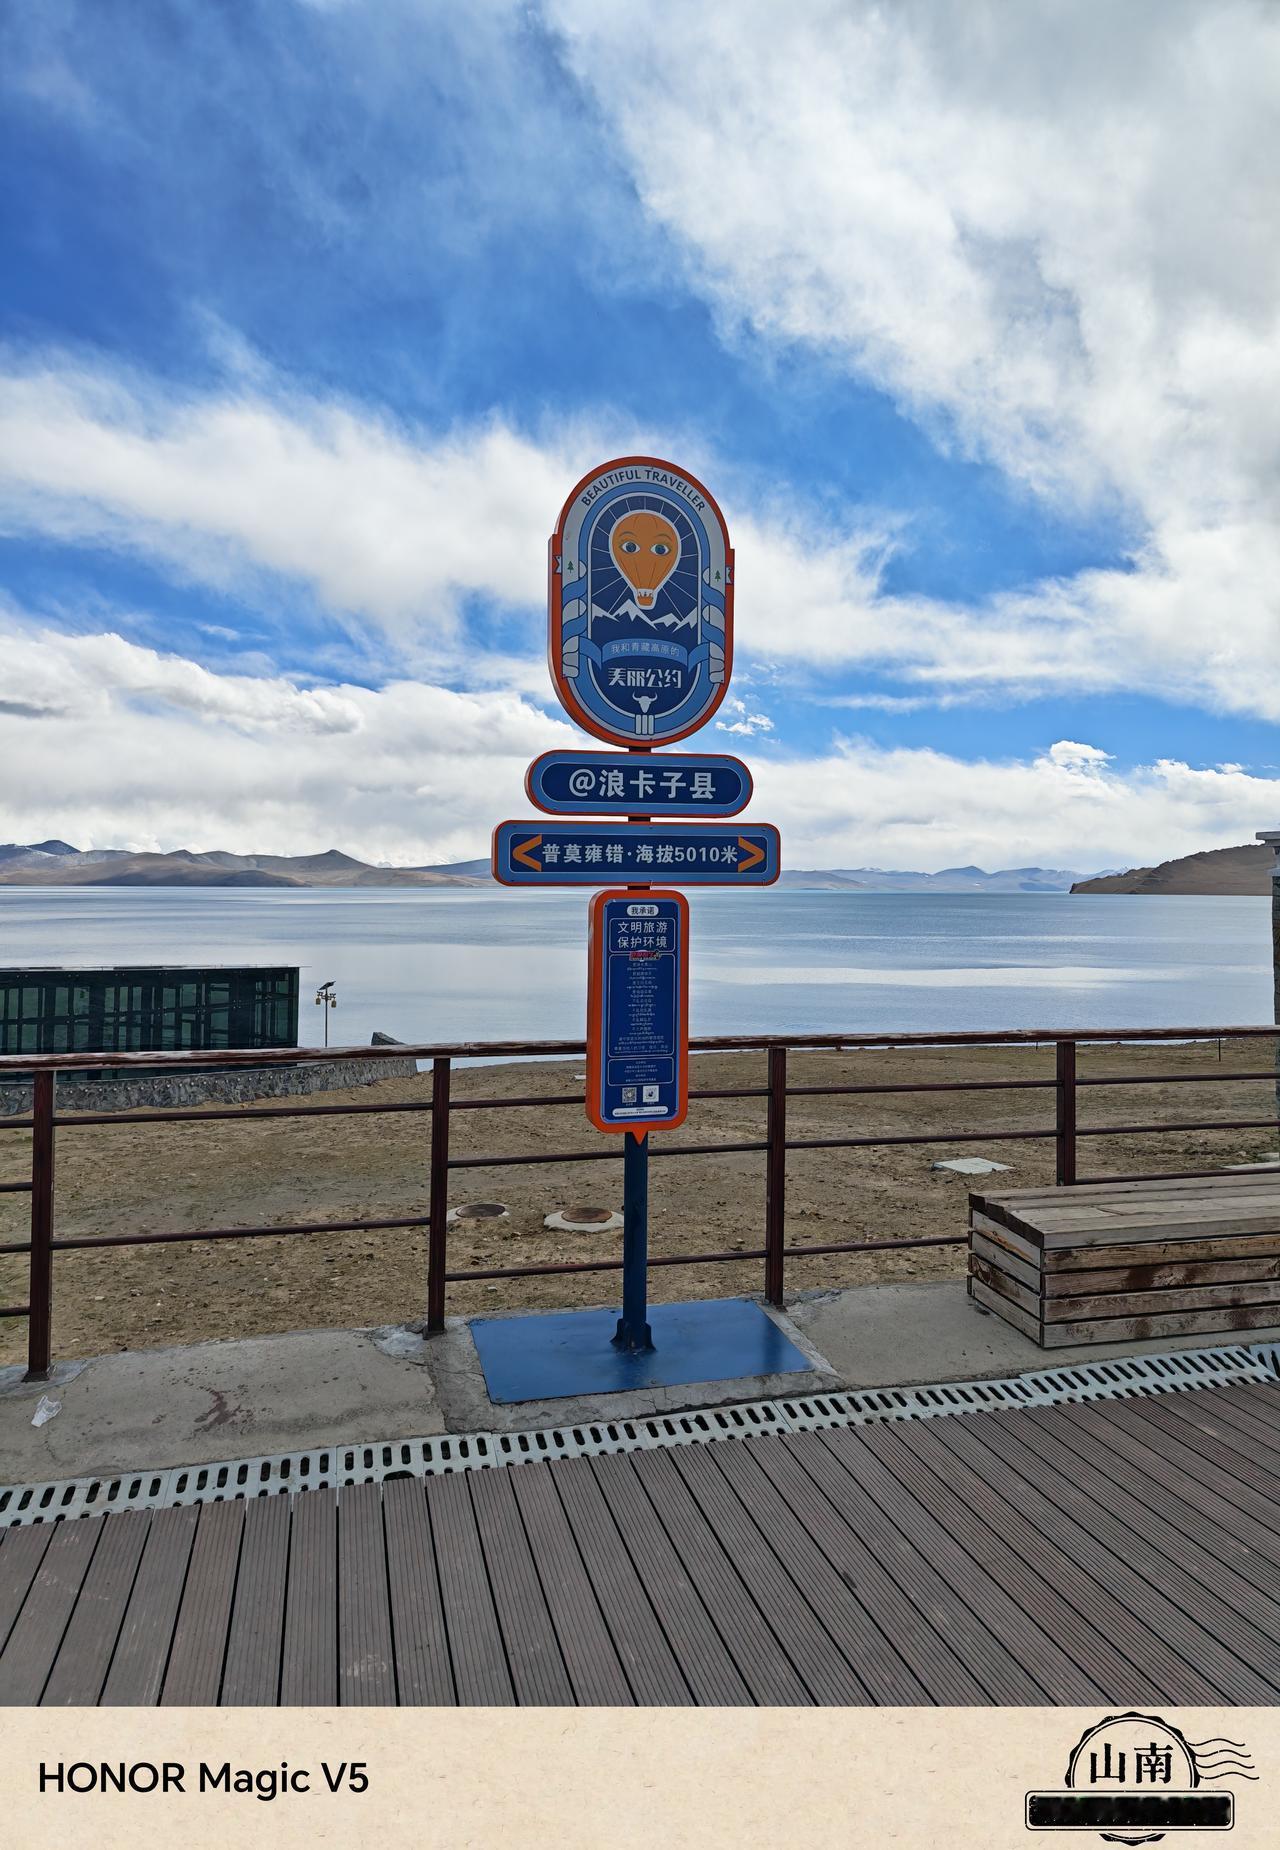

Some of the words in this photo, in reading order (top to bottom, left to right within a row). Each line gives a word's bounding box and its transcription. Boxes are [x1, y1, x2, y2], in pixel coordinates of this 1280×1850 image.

[581, 469, 641, 506] BEAUTIFUL
[644, 469, 706, 511] TRAVELLER
[611, 642, 680, 656] 我和青藏高原的
[608, 667, 682, 689] 美丽公约
[569, 768, 716, 799] @浪卡子县
[631, 906, 655, 915] 我承诺
[617, 921, 668, 934] 文明旅游
[617, 936, 668, 949] 保护环境
